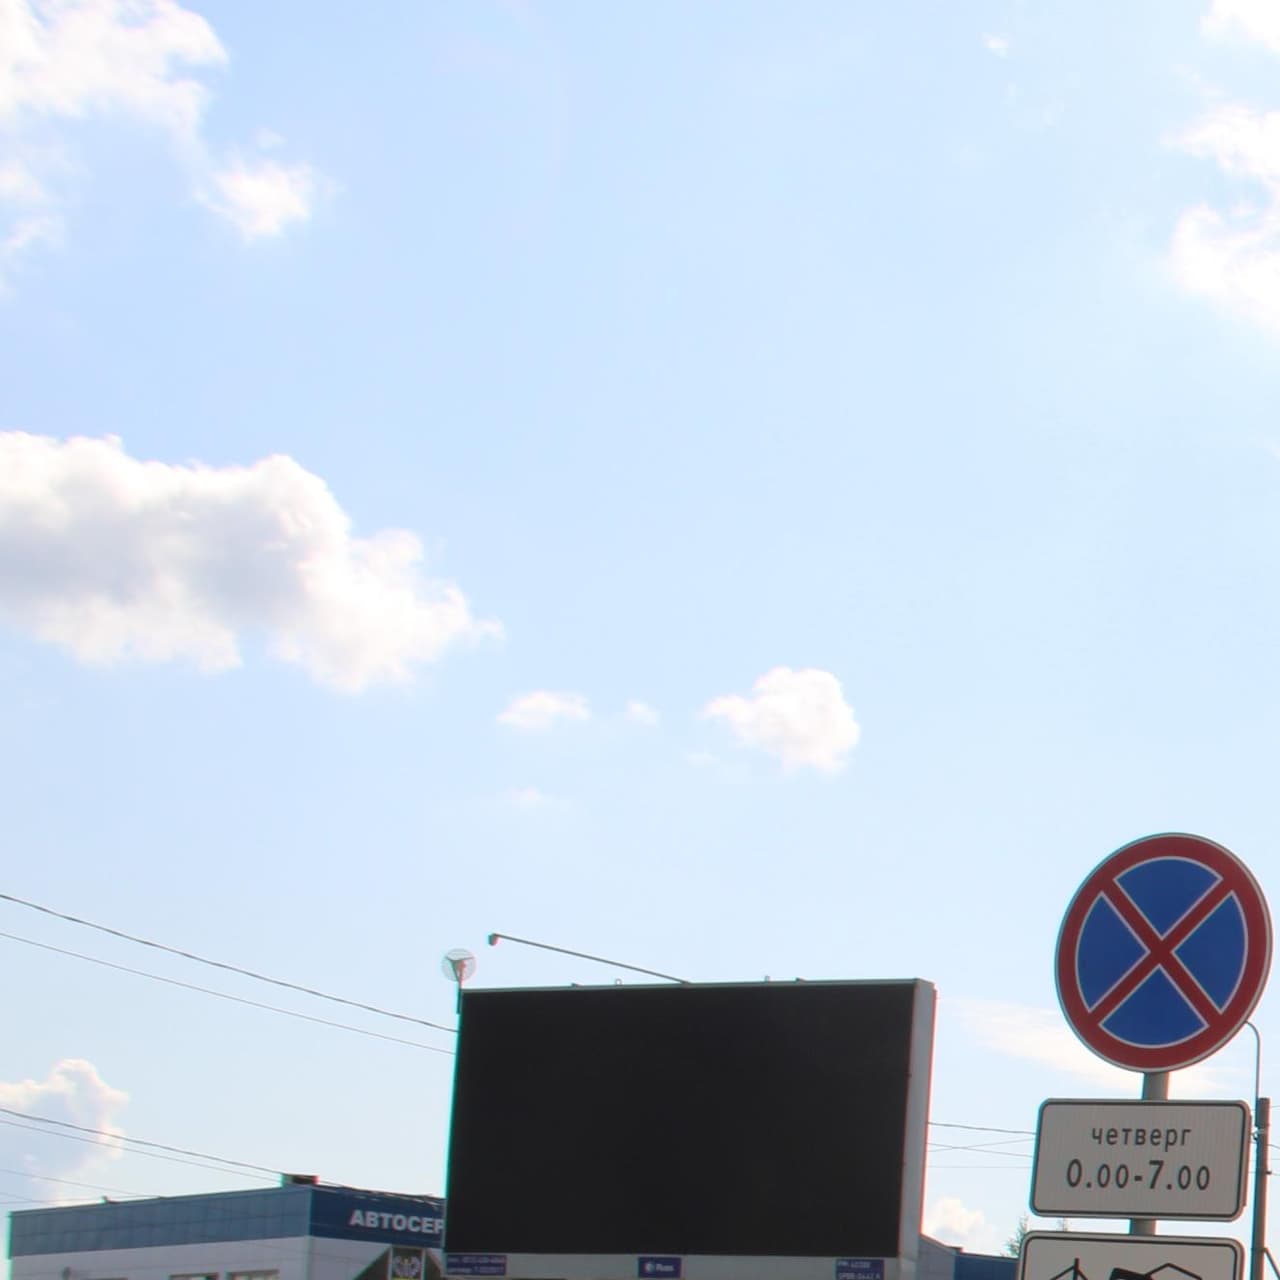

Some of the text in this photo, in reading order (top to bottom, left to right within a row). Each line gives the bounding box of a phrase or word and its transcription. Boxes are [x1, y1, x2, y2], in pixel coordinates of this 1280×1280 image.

[1091, 1127, 1192, 1152] четверг
[1066, 1158, 1211, 1191] 0.00-7.00
[349, 1209, 445, 1234] АВТОСЕР
